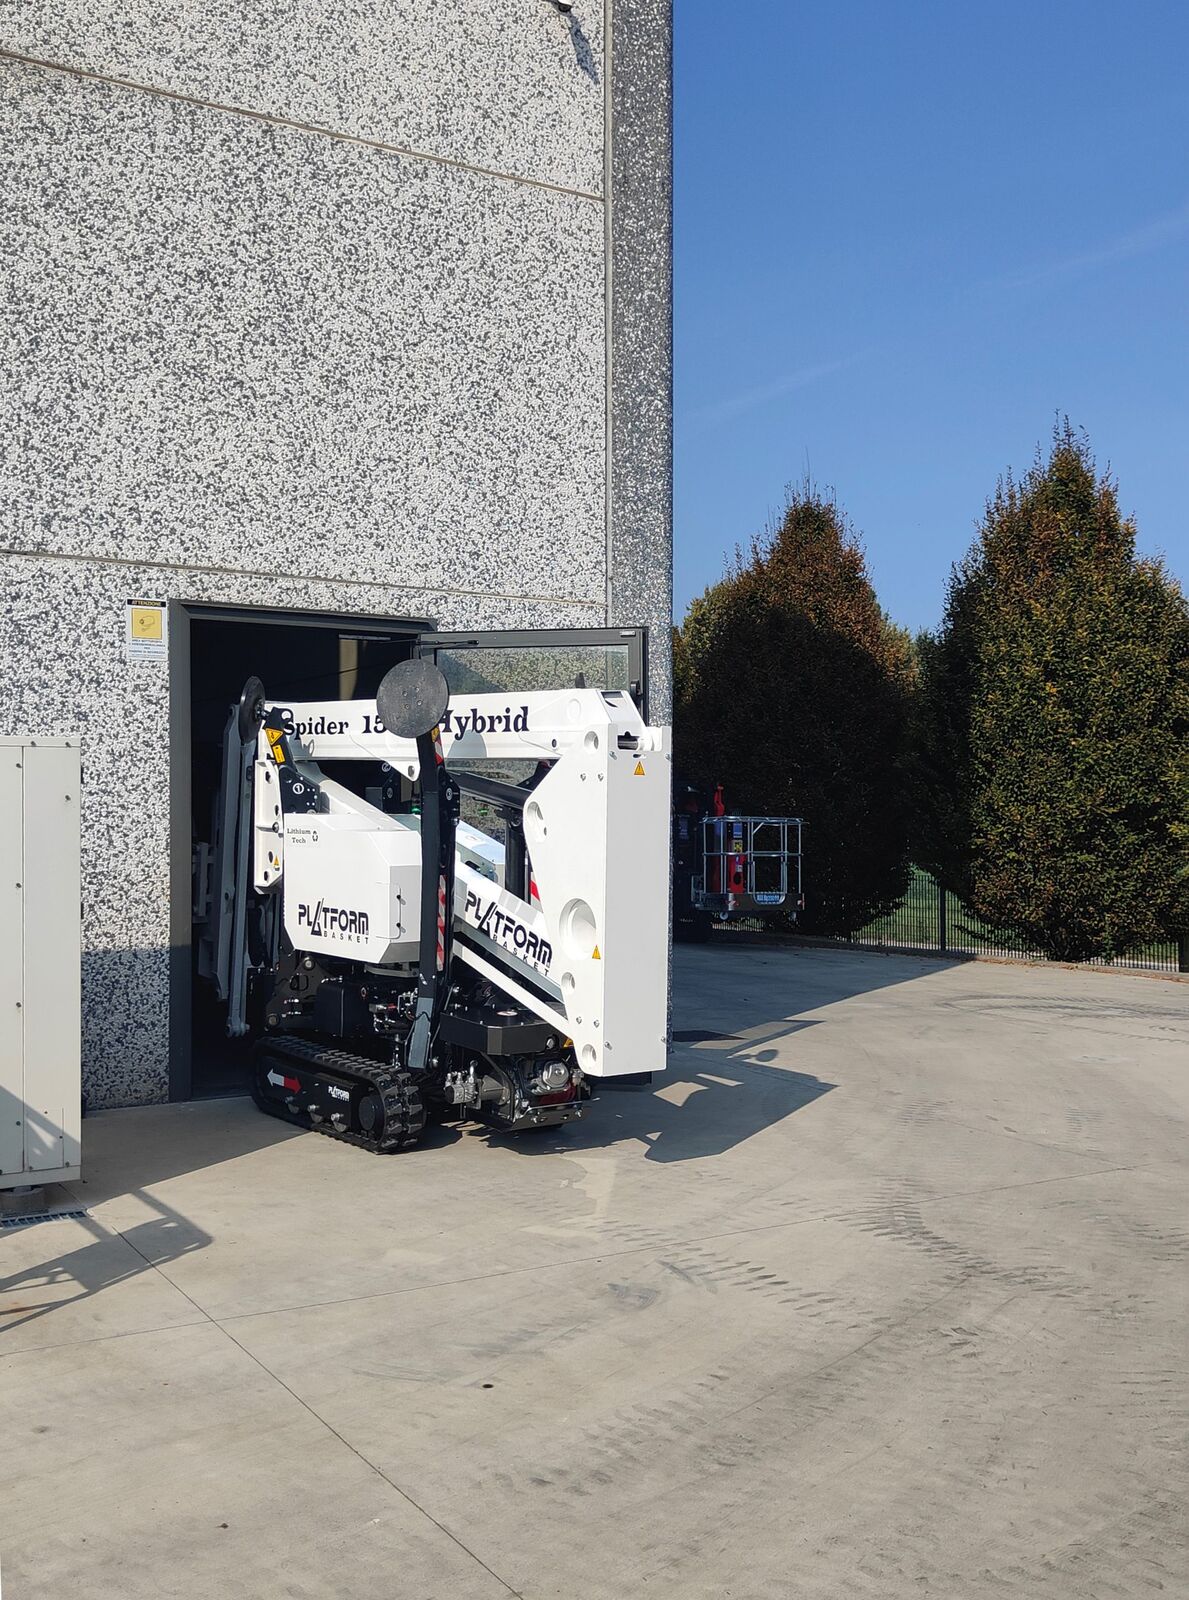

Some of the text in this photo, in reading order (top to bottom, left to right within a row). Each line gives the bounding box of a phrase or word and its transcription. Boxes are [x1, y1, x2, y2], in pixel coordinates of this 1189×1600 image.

[438, 706, 529, 741] Hybrid
[298, 898, 369, 936] PLATFORM
[465, 891, 553, 966] PLATFORM
[324, 930, 369, 945] BASKET
[492, 934, 550, 977] BASKET
